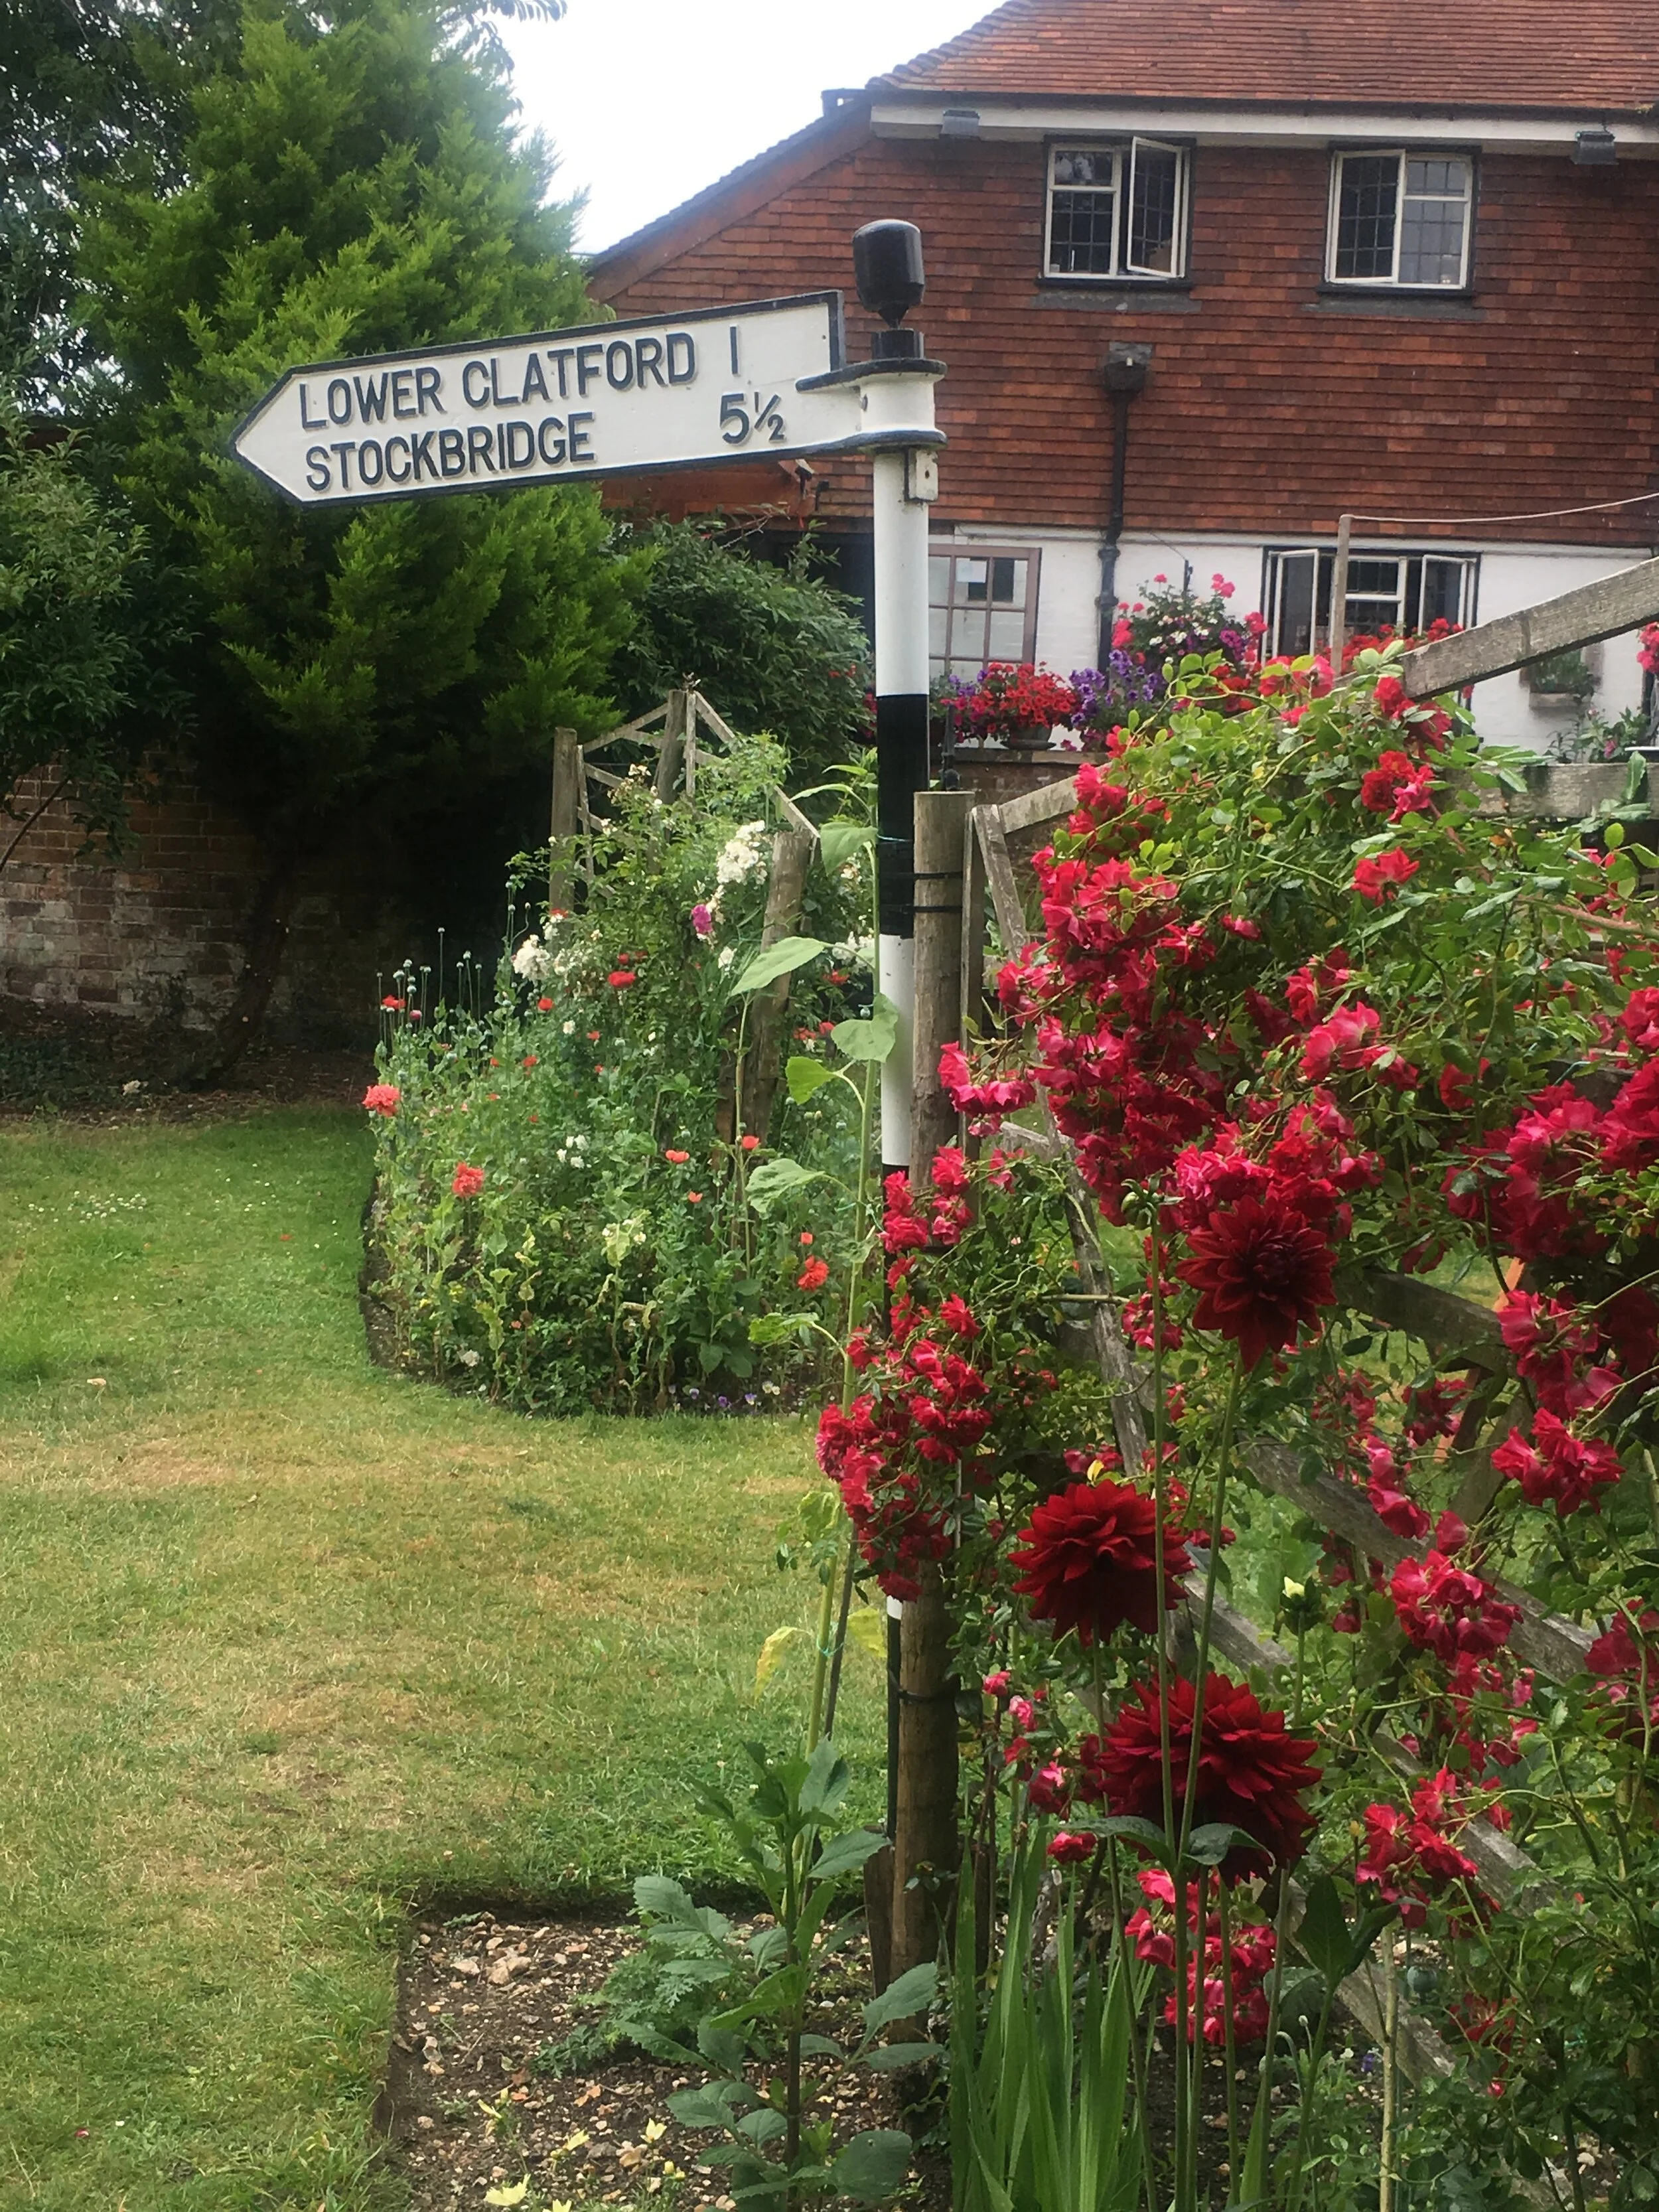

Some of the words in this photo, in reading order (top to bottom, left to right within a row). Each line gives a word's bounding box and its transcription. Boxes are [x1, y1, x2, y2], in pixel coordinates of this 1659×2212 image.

[299, 366, 447, 429] LOWER
[463, 332, 696, 408] CLATFORD
[305, 411, 595, 491] STOCKBRIDGE
